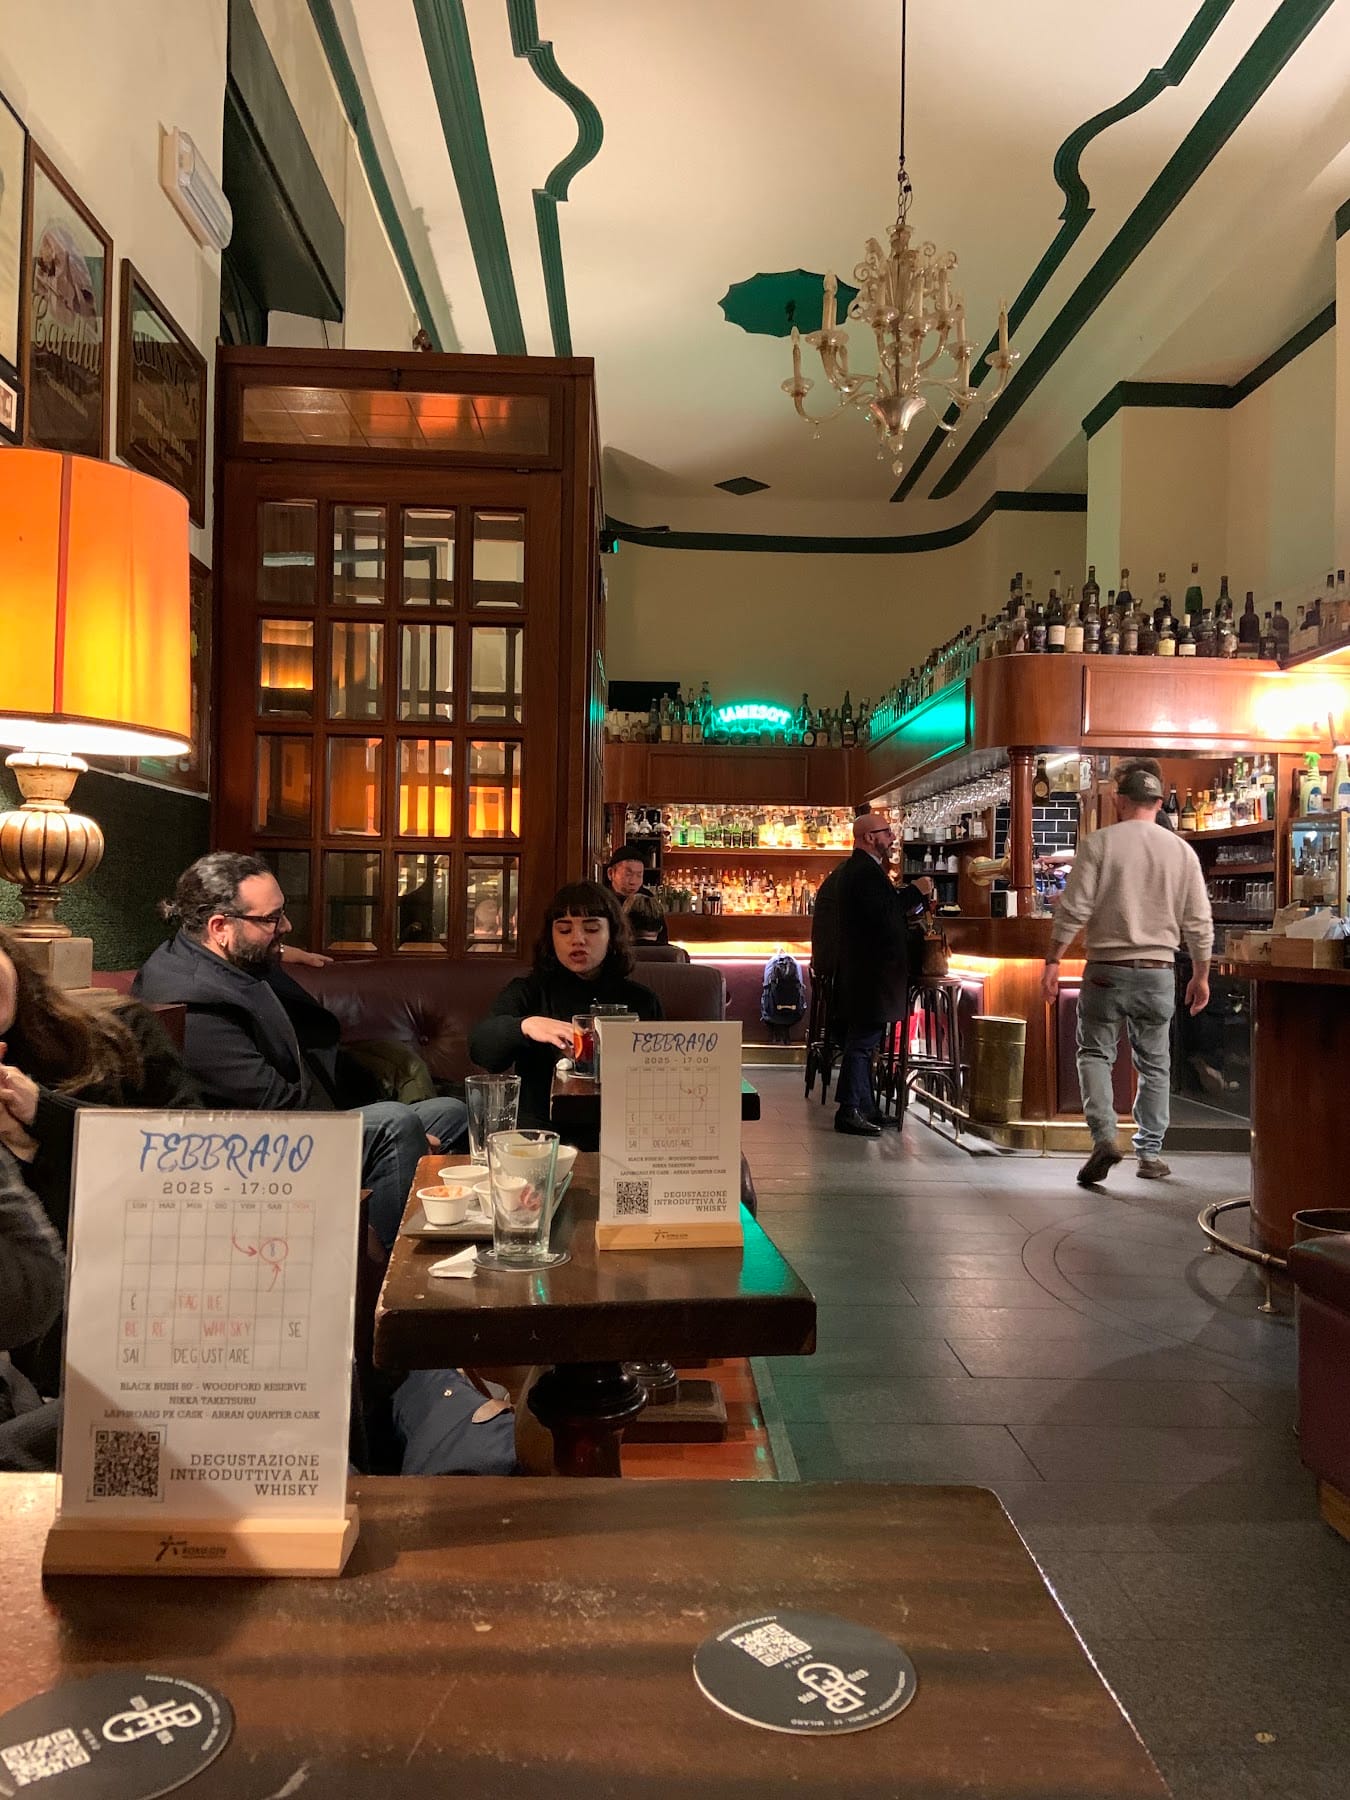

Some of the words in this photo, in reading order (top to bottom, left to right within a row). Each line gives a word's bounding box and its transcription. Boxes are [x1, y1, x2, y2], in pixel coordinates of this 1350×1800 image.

[632, 1032, 718, 1056] FEBBRAIO
[140, 1129, 314, 1179] FEBBRAIO
[162, 1182, 213, 1195] 2025
[240, 1182, 293, 1195] 17:00
[288, 1321, 301, 1337] SE
[120, 1382, 151, 1391] BLACK
[202, 1382, 261, 1391] WOODFORD
[247, 1411, 292, 1420] QUARTER
[294, 1411, 320, 1420] CASK
[190, 1454, 320, 1467] DEGUSTAZIONE
[170, 1468, 293, 1481] INTRODUTTIVA
[299, 1469, 319, 1481] AL
[255, 1484, 319, 1496] WHISKY
